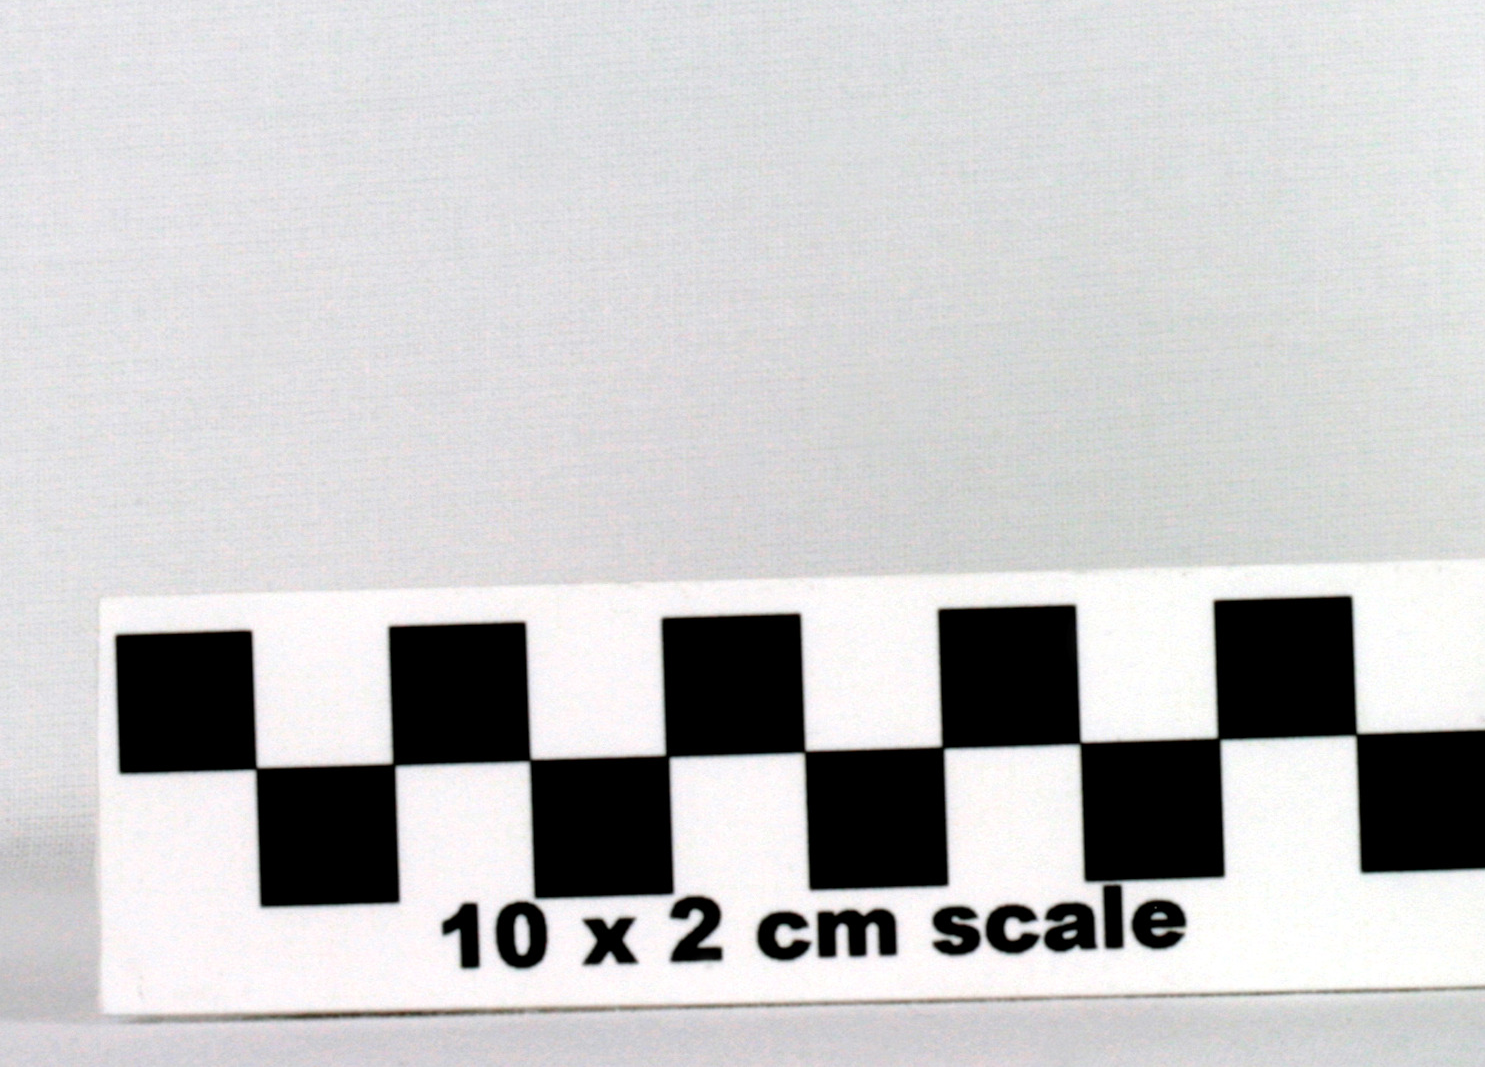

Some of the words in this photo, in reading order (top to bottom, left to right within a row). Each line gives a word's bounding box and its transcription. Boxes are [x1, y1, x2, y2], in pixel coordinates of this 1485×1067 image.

[441, 901, 548, 969] 10
[583, 917, 638, 966] x
[670, 895, 723, 963] 2
[756, 908, 898, 961] cm
[932, 883, 1187, 956] scale
